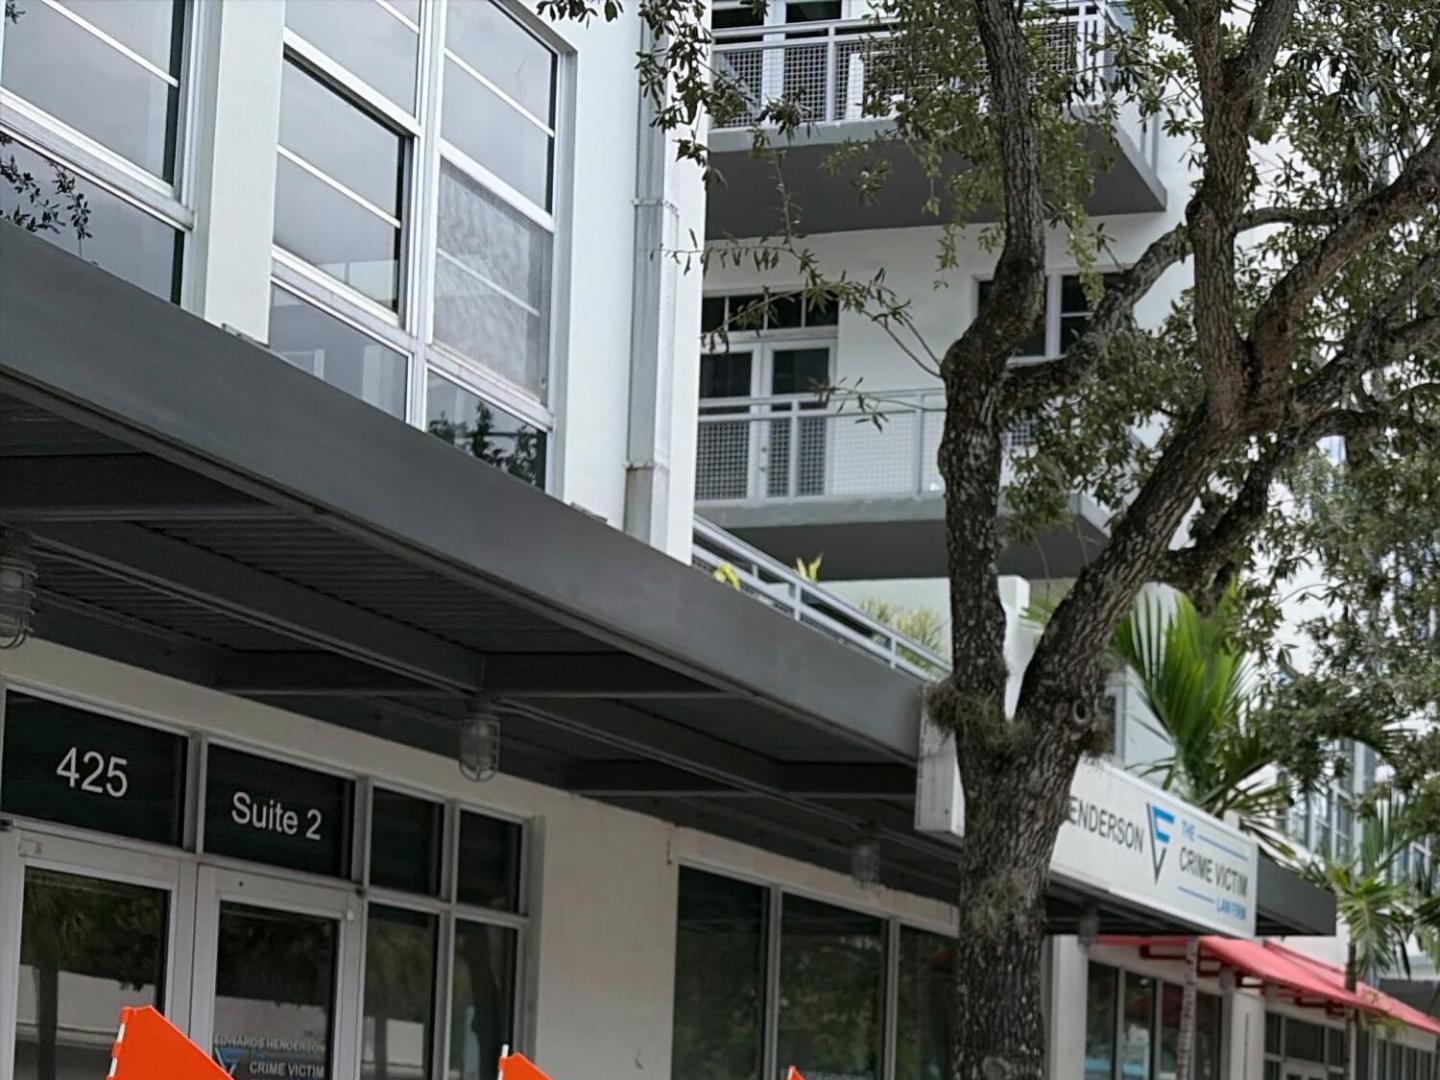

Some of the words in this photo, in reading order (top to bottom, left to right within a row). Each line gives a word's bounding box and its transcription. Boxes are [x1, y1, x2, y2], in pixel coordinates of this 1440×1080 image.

[56, 747, 128, 798] 425
[231, 791, 298, 835] Suite
[306, 809, 322, 840] 2
[1069, 796, 1145, 854] ENDERSON
[1179, 847, 1213, 883] CRIME
[1216, 861, 1248, 898] VICTIM
[249, 1060, 286, 1077] CRIME
[287, 1063, 325, 1079] VICTIM
